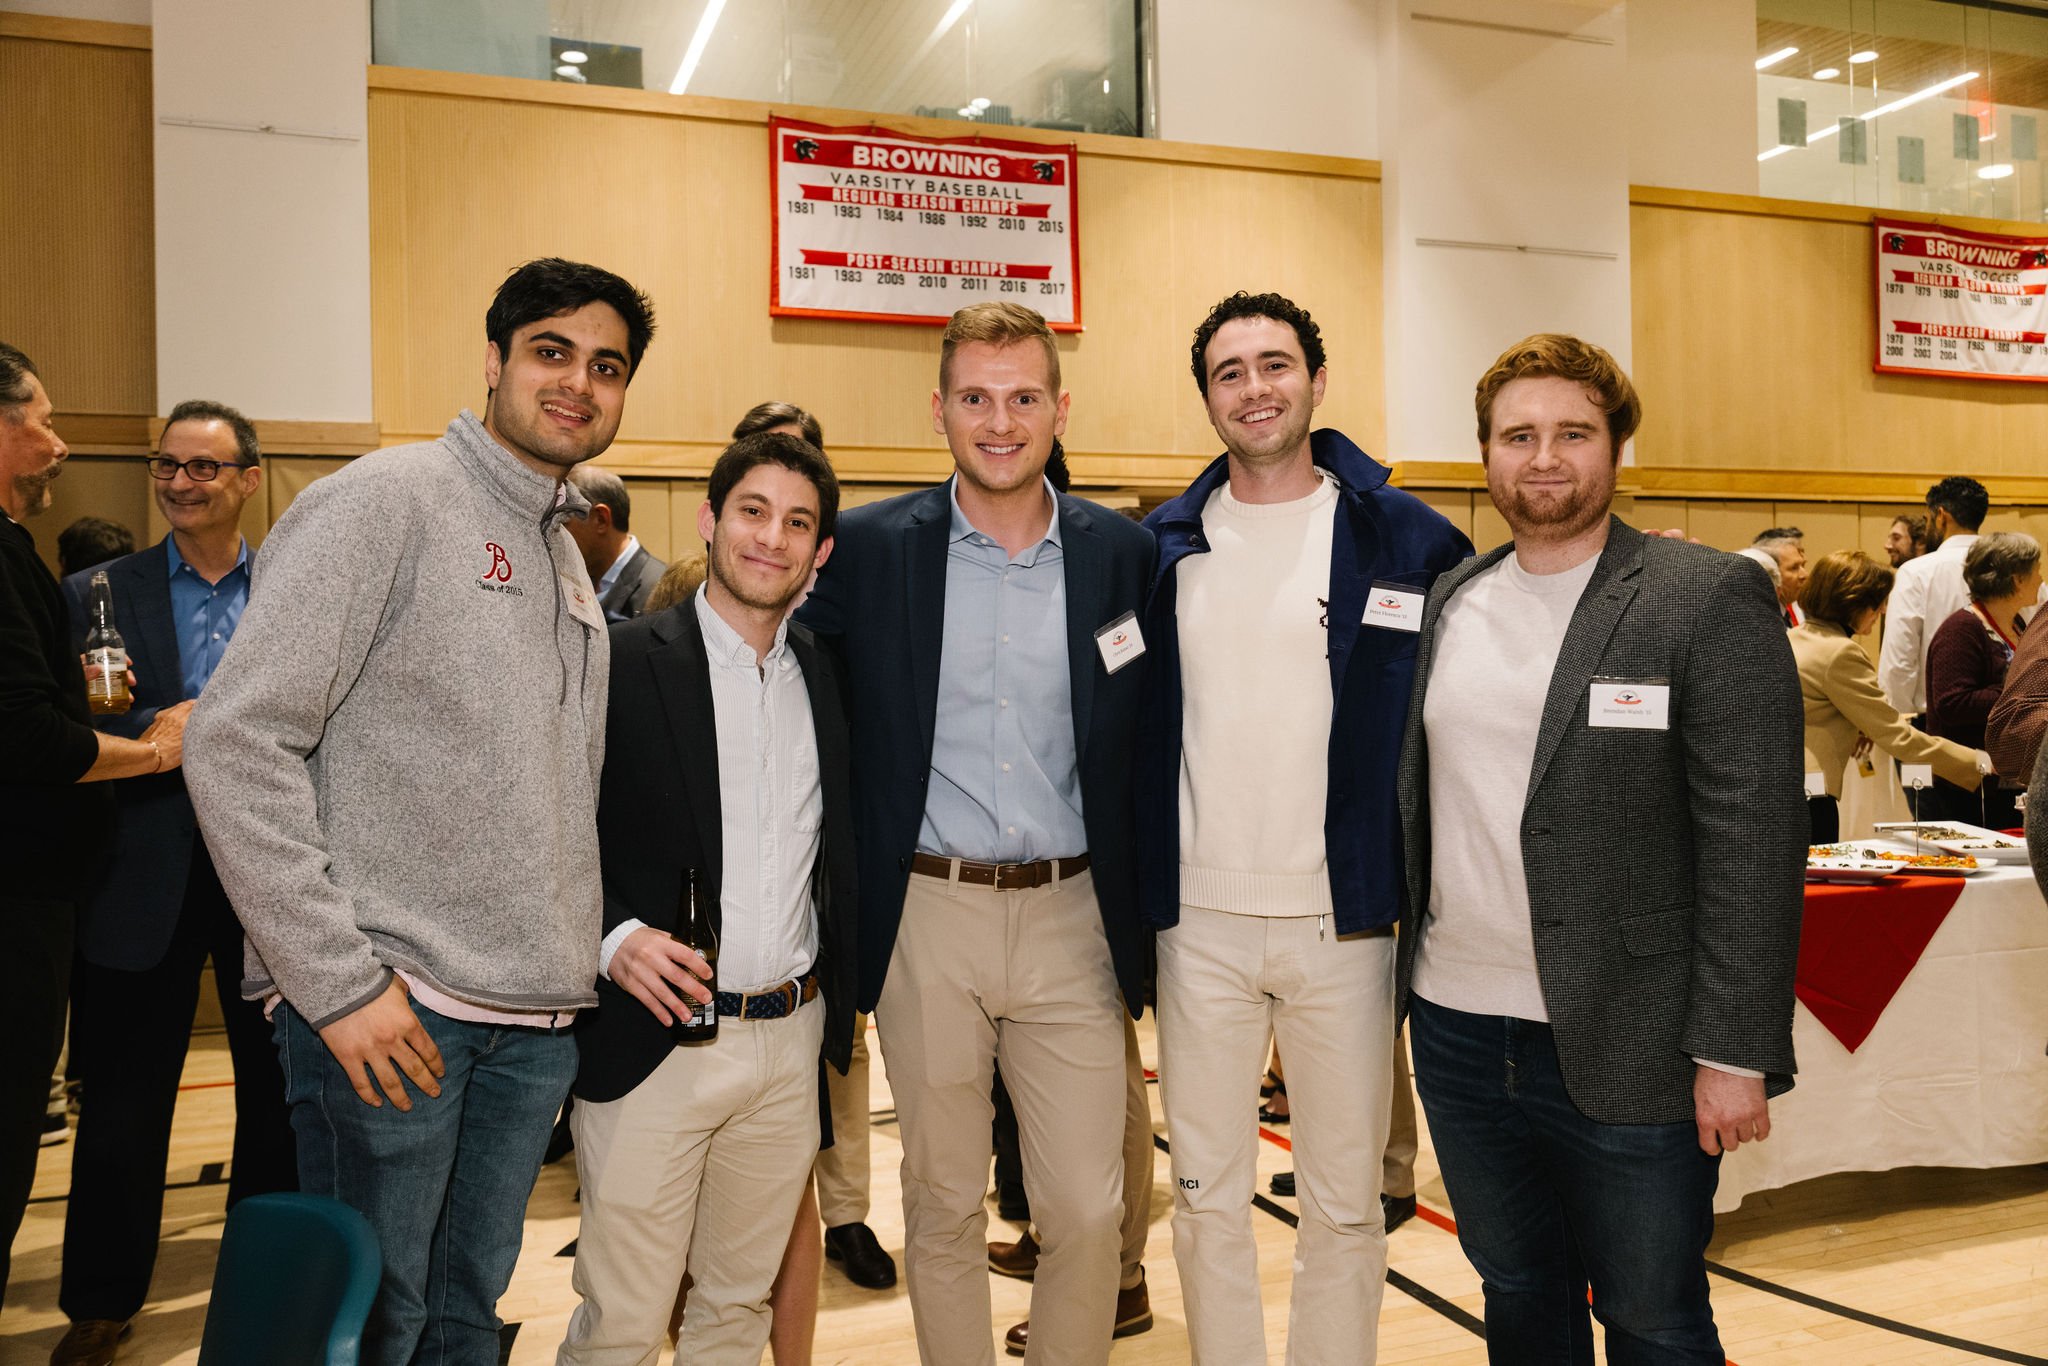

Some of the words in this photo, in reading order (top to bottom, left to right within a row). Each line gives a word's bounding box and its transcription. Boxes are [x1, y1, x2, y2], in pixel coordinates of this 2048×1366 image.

[852, 145, 1001, 178] BROWNING
[830, 172, 916, 192] VARSITY
[925, 180, 1024, 200] BASEBALL
[832, 187, 896, 206] REGULAR
[901, 194, 957, 212] SEASON
[961, 198, 1019, 215] CHAMPS
[787, 200, 815, 215] 1981
[833, 204, 861, 219] 1983
[877, 208, 903, 222] 1984
[918, 211, 946, 226] 1986
[960, 214, 987, 228] 1992
[998, 217, 1026, 231] 2010
[1037, 220, 1064, 234] 2015
[846, 253, 945, 274] POST-SEASON
[950, 260, 1008, 277] CHAMPS
[1925, 239, 2022, 268] BROWNING
[788, 266, 816, 280] 1981
[834, 269, 862, 283] 1983
[877, 272, 905, 286] 2009
[919, 276, 947, 289] 2010
[961, 278, 988, 291] 2011
[999, 280, 1027, 293] 2016
[1040, 282, 1066, 295] 2017
[1973, 270, 2020, 284] SOCCER
[482, 541, 513, 583] B
[475, 579, 496, 592] Class
[496, 584, 505, 593] of
[505, 585, 523, 597] 2015
[1179, 1177, 1199, 1190] RCI
